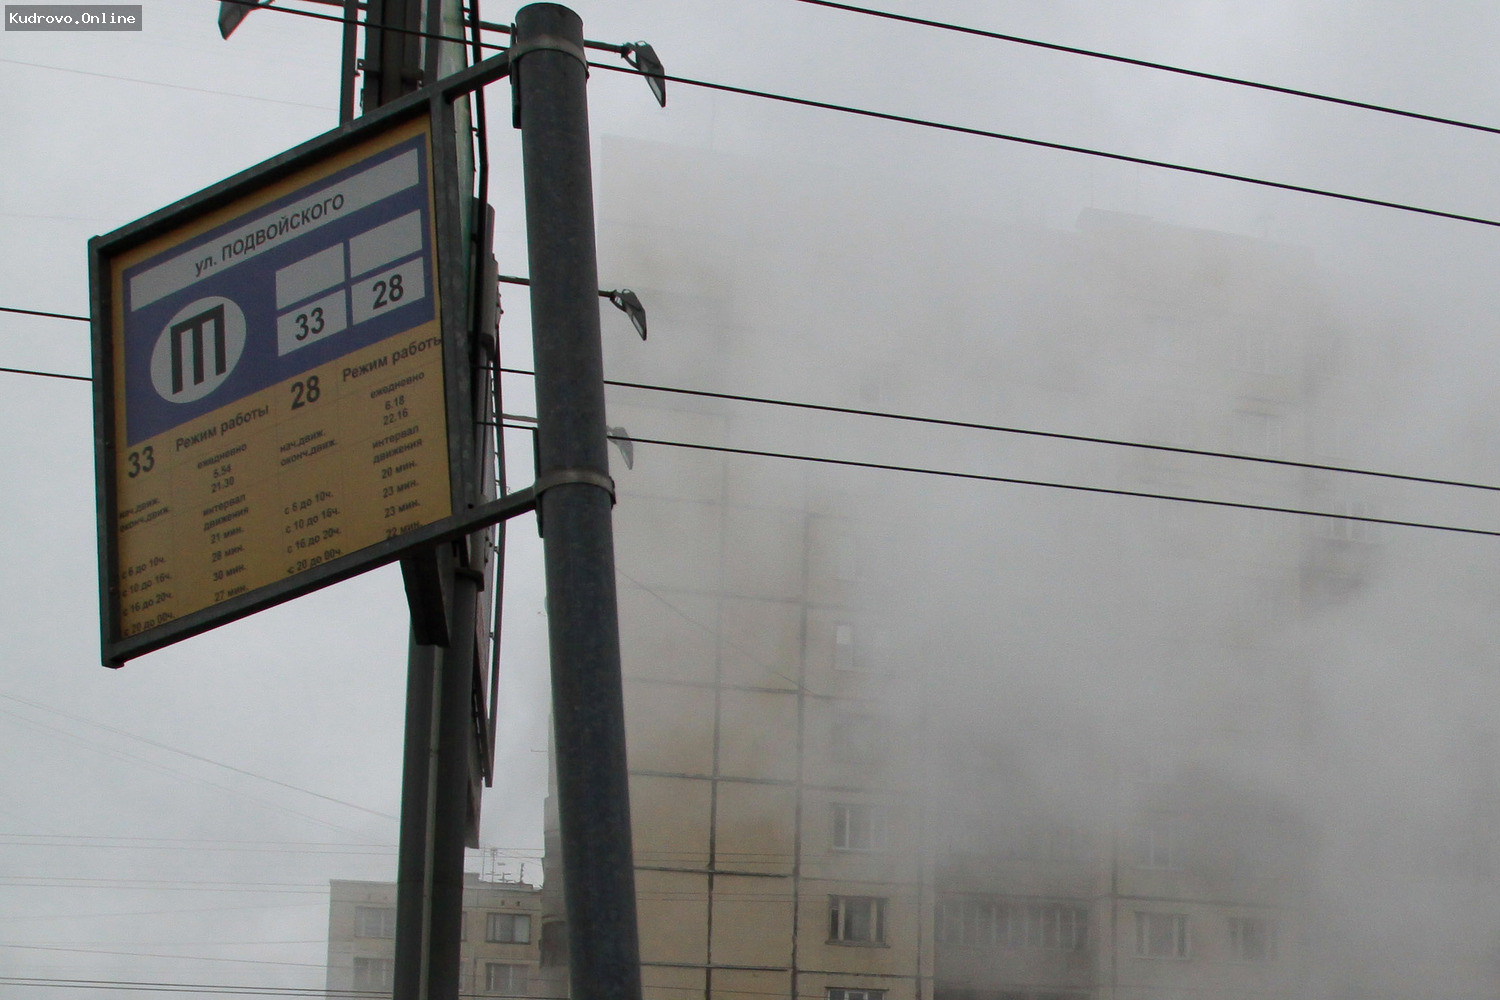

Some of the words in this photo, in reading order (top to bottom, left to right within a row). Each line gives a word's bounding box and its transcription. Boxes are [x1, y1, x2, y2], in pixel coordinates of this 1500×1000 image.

[195, 256, 217, 277] ул.
[221, 194, 345, 261] ПОДВОЙСКОГО
[372, 273, 404, 310] 28
[295, 307, 325, 341] 33
[342, 355, 388, 382] Режим
[290, 375, 320, 410] 28
[370, 372, 425, 399] ежедневно
[176, 427, 217, 451] Режим
[221, 405, 269, 436] работы
[372, 425, 419, 449] интервал
[128, 446, 155, 478] 33
[373, 439, 422, 465] движения
[300, 498, 312, 510] до
[307, 515, 318, 527] до
[308, 535, 320, 547] до
